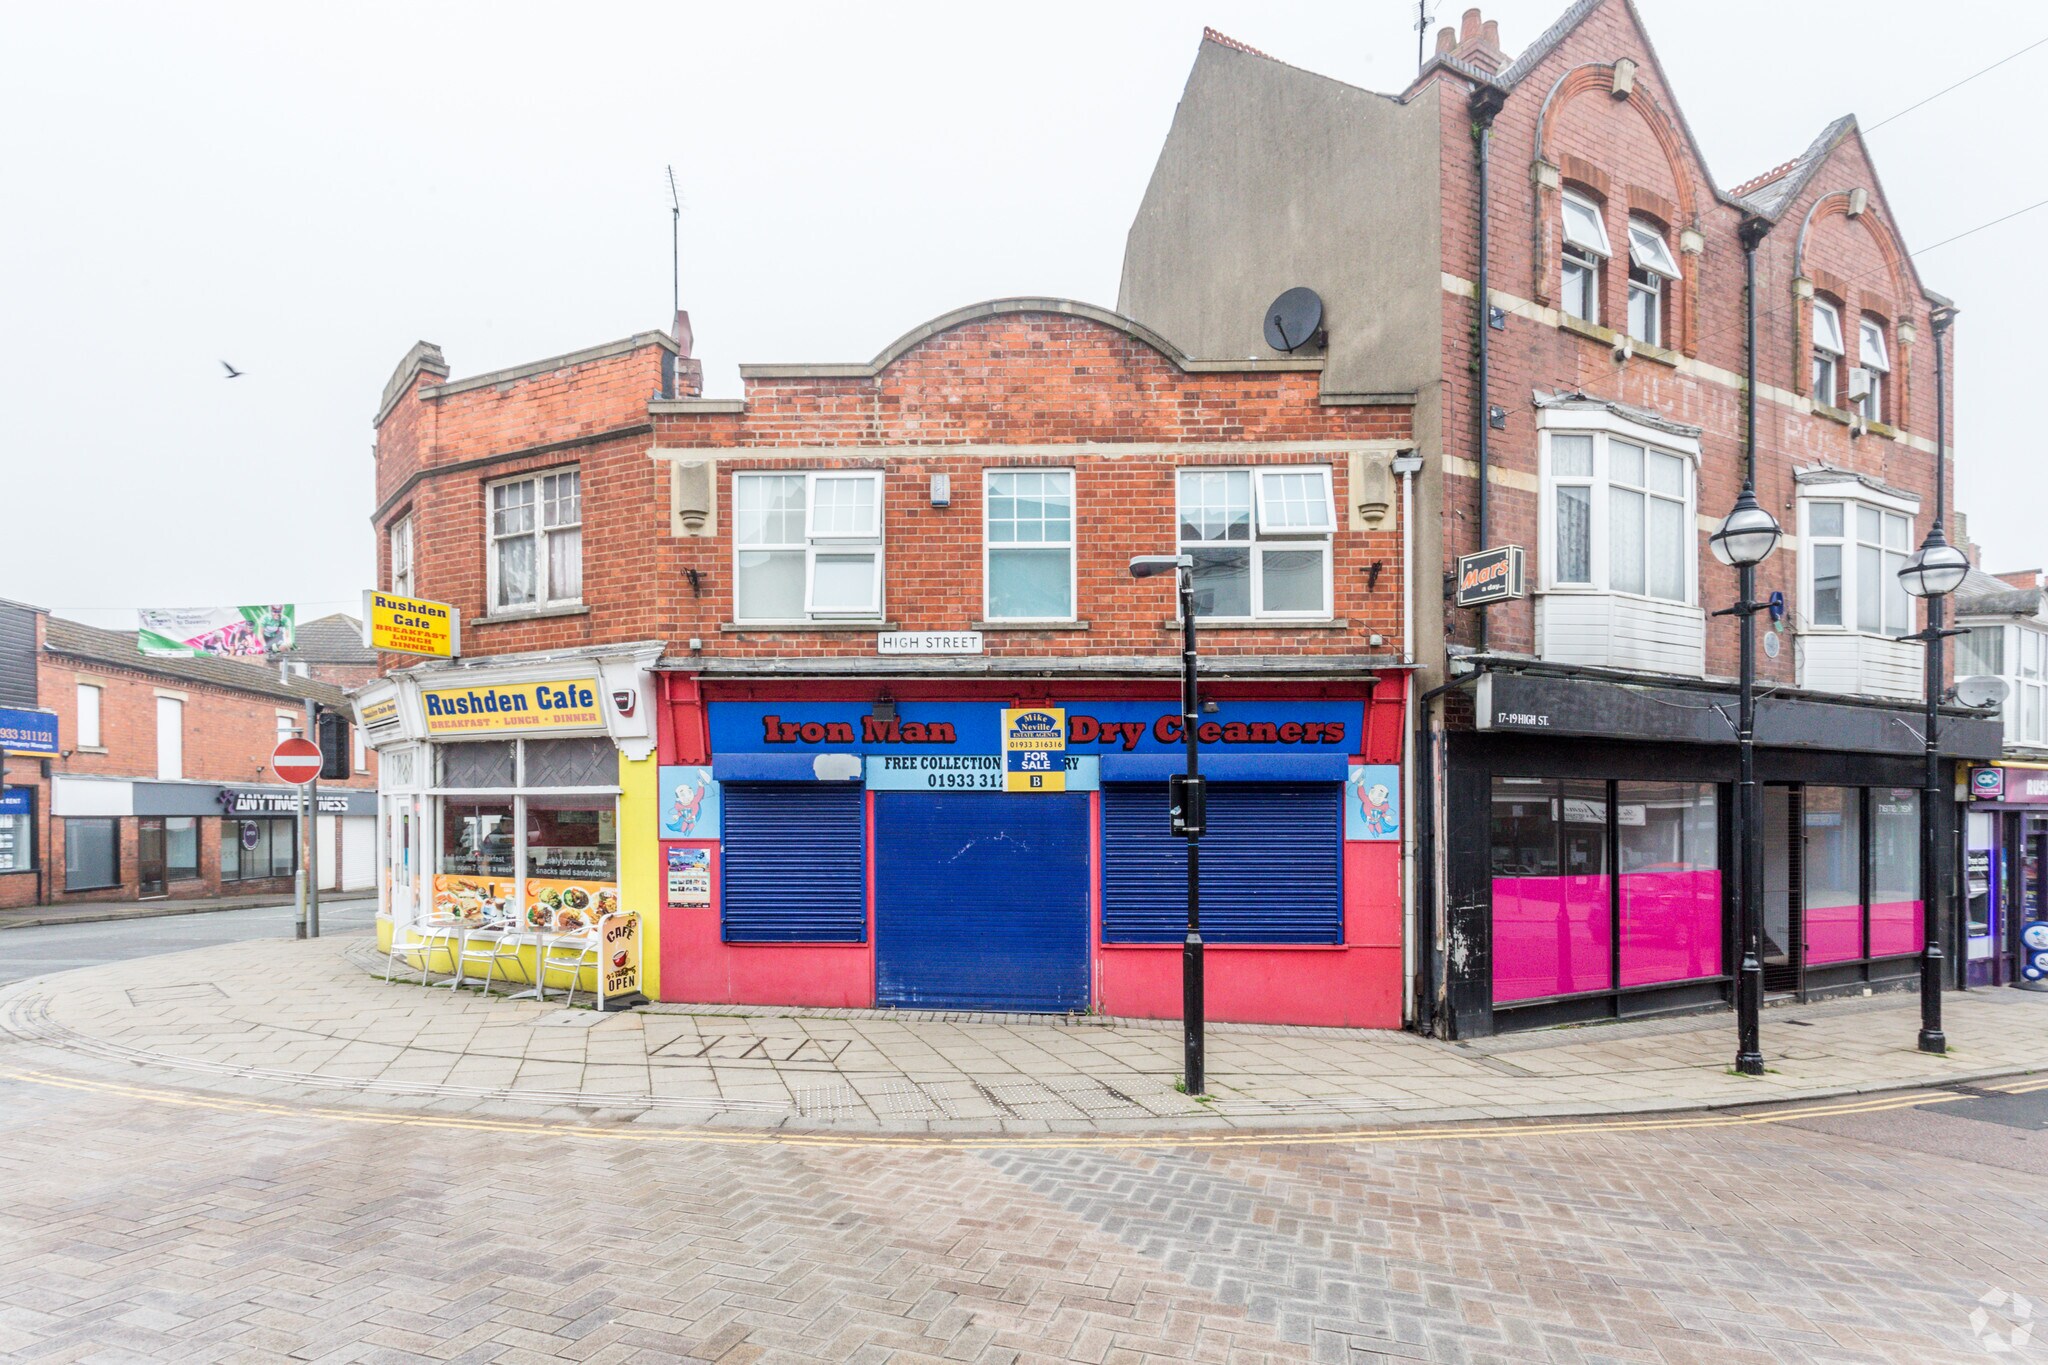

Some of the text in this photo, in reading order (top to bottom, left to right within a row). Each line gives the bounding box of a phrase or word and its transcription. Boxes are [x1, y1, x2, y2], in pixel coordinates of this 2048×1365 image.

[1461, 559, 1509, 591] Mars
[375, 595, 447, 619] Rushden
[393, 613, 430, 629] Cafe
[375, 623, 447, 640] BREAKFAST
[389, 640, 435, 652] DINNER
[392, 634, 432, 645] LUNCH
[882, 636, 978, 649] HIGH STREET
[425, 684, 594, 716] Rushden Cafe
[431, 712, 598, 729] BREAKFAST LUNCH DINNER
[1023, 713, 1048, 723] Mike
[1498, 712, 1550, 726] 17-19 HIGH ST.
[763, 715, 957, 744] Iron Man
[1021, 723, 1051, 731] Neville
[1068, 714, 1345, 751] Dry Ceaners
[20, 729, 53, 743] 311121
[885, 757, 917, 770] FREE
[920, 756, 1001, 770] COLLECTION
[1024, 752, 1048, 760] FOR
[1021, 761, 1051, 770] SALE
[928, 774, 975, 788] 01933
[1033, 776, 1041, 787] B
[235, 793, 299, 811] ANYTIME
[562, 858, 586, 866] ground
[586, 858, 607, 867] coffee
[497, 866, 514, 874] week
[535, 866, 611, 878] snacks and sandwiches
[606, 926, 635, 943] CAFE
[608, 975, 635, 992] OPEN
